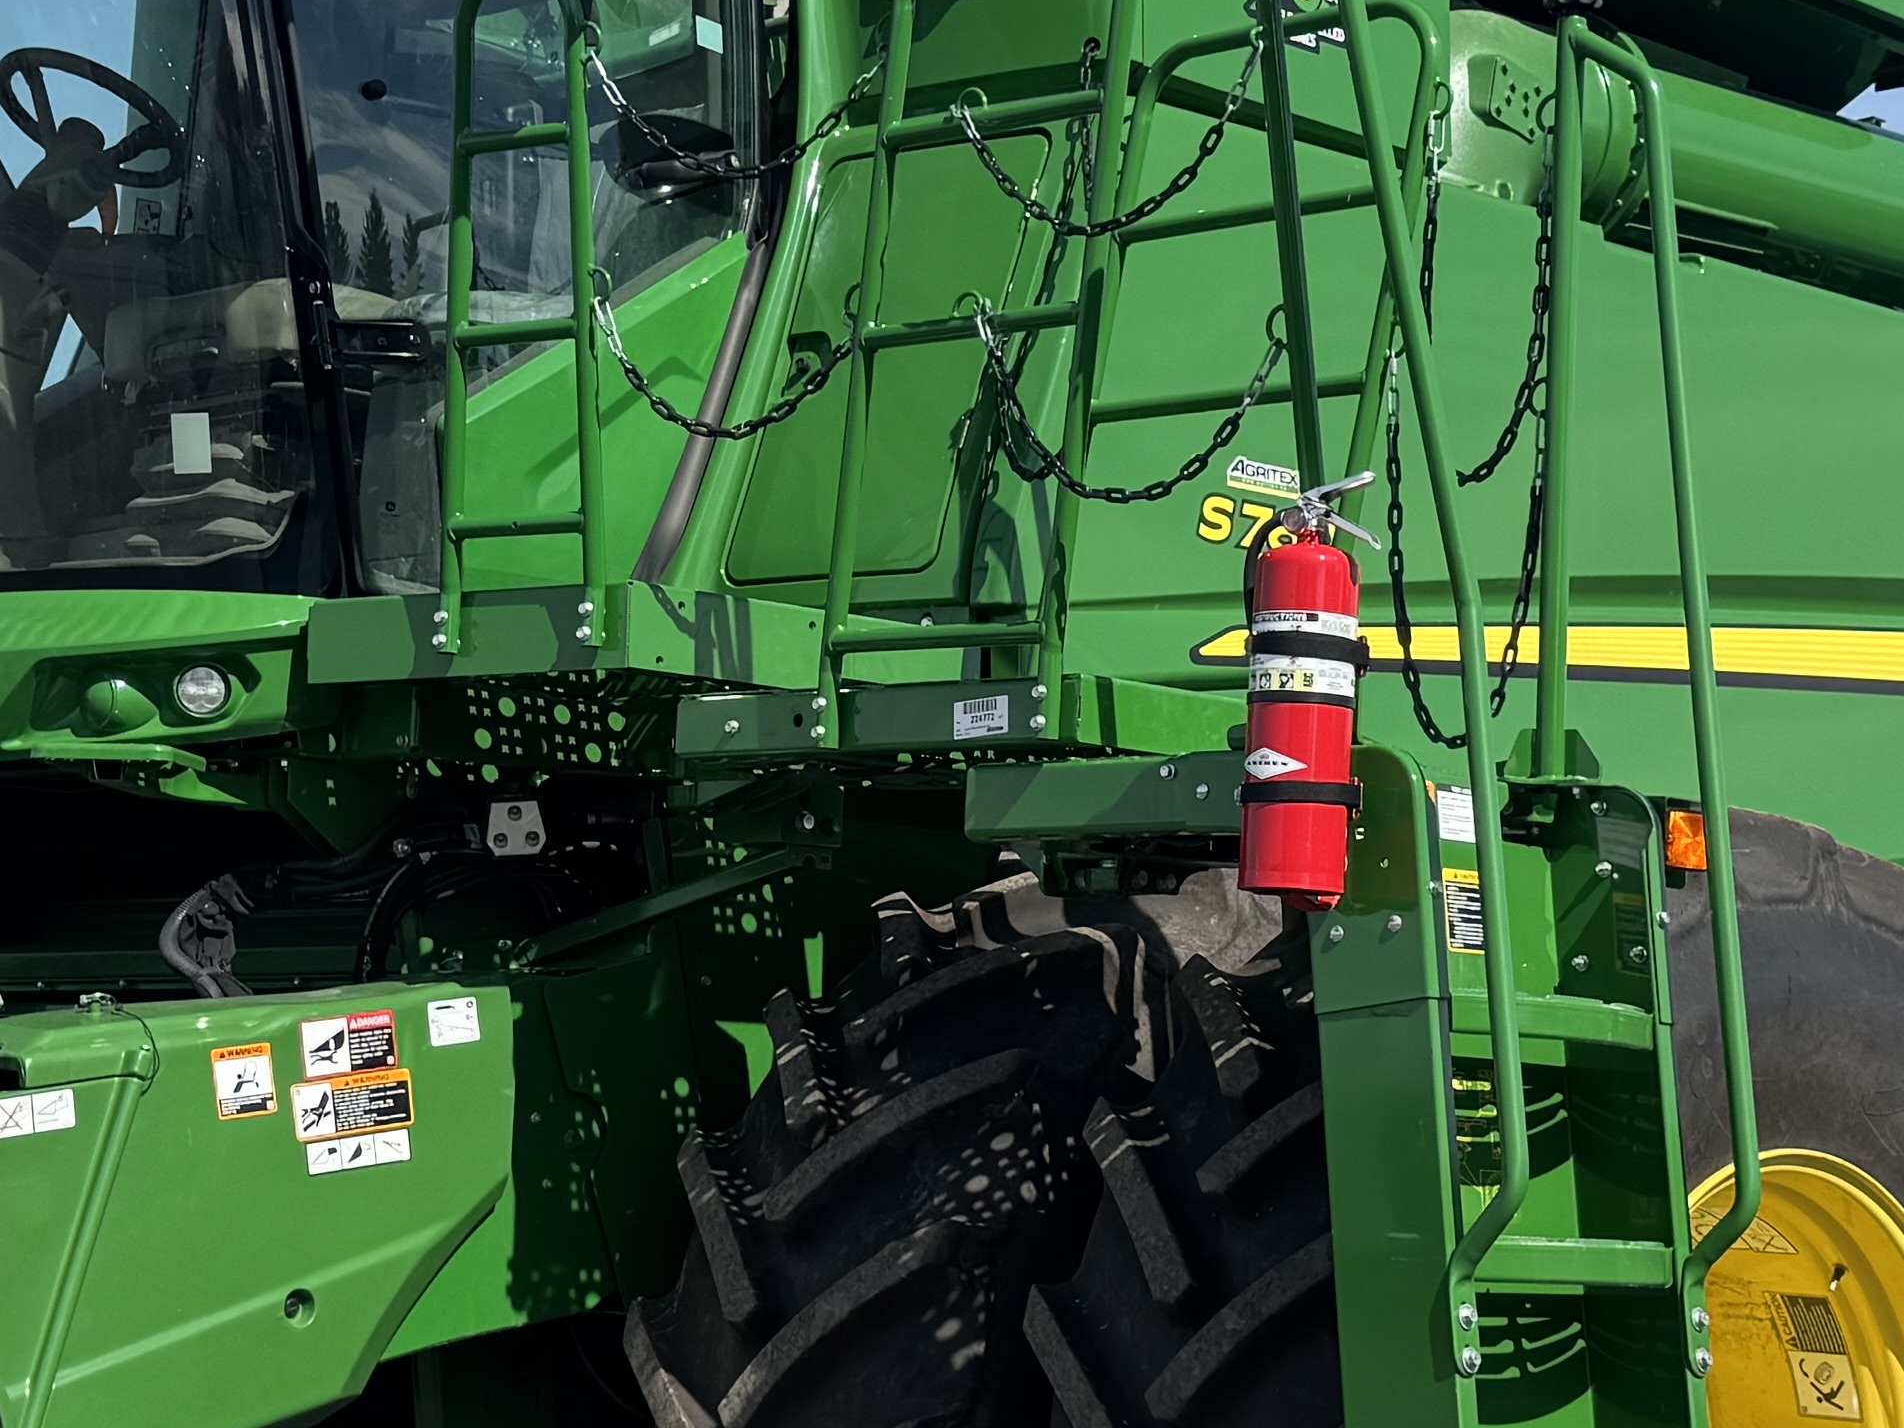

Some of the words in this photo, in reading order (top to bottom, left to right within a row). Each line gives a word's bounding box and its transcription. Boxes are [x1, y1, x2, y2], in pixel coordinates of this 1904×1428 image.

[1231, 459, 1298, 485] AGRITEX
[356, 1014, 391, 1029] DANGER
[226, 1045, 264, 1057] WARNING
[351, 1073, 390, 1085] WARNING
